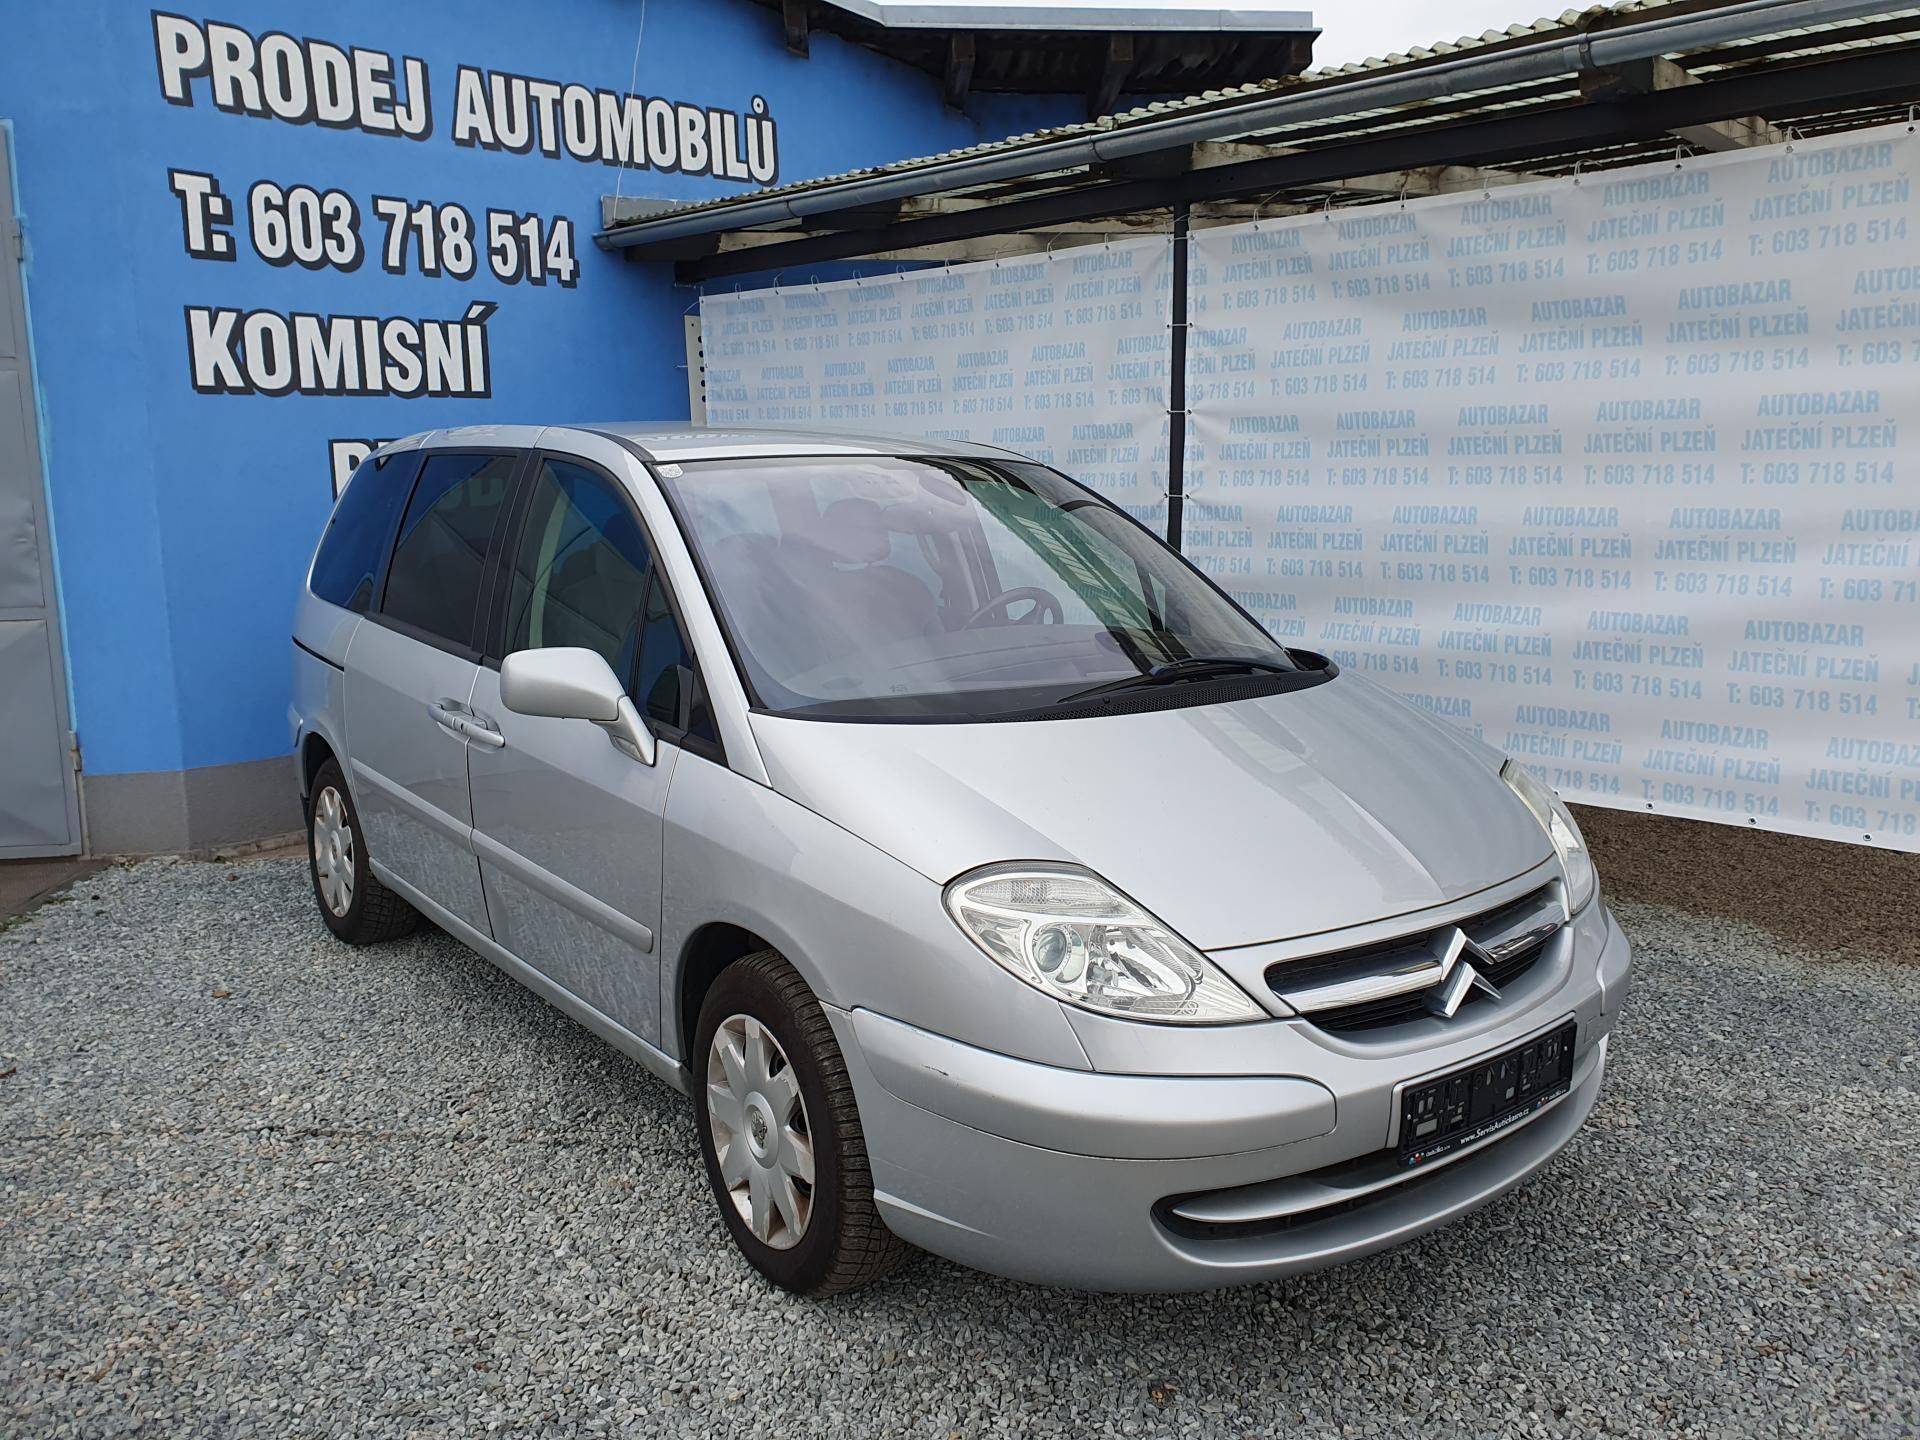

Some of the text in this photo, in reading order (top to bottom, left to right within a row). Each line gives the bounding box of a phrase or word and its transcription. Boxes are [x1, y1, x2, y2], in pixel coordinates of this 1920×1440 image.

[154, 12, 777, 184] PRODEJ AUTOMOBILŮ
[1768, 144, 1893, 184] AUTOBAZAR
[1603, 171, 1710, 207] AUTOBAZAR
[1749, 172, 1909, 221] JATEČNÍ PLZEŇ
[1460, 195, 1553, 226] AUTOBAZAR
[1586, 198, 1723, 244] JATEČNÍ PLZEŇ
[171, 170, 577, 284] T: 603 718 514
[1446, 219, 1565, 258] JATEČNÍ PLZEŇ
[1748, 217, 1906, 256] T: 603 718 514
[1071, 252, 1134, 276] AUTOBAZAR
[1586, 239, 1722, 273] T: 603 718 514
[989, 264, 1046, 286] AUTOBAZAR
[1447, 257, 1563, 288] T: 603 718 514
[1531, 295, 1627, 321] AUTOBAZAR
[1678, 279, 1791, 310] AUTOBAZAR
[995, 317, 1014, 333] 603
[1017, 315, 1034, 330] 718
[1036, 312, 1052, 328] 514
[1075, 307, 1093, 324] 603
[1097, 304, 1116, 321] 718
[1119, 302, 1142, 320] 514
[1402, 307, 1487, 331] AUTOBAZAR
[1665, 306, 1808, 343] JATEČNÍ PLZEŇ
[187, 302, 491, 394] KOMISNÍ
[1387, 331, 1498, 360] JATEČNÍ PLZEŇ
[1518, 320, 1642, 353] JATEČNÍ PLZEŇ
[956, 349, 1009, 369] AUTOBAZAR
[1031, 342, 1085, 361] AUTOBAZAR
[1665, 348, 1808, 375] T: 603 718 514
[1385, 366, 1495, 389] T: 603 718 514
[1516, 359, 1640, 383] T: 603 718 514
[961, 399, 977, 413] 603
[980, 397, 994, 412] 718
[996, 396, 1013, 411] 514
[1034, 394, 1051, 409] 603
[1054, 392, 1072, 408] 718
[1075, 392, 1094, 407] 514
[1596, 399, 1700, 422] AUTOBAZAR
[1756, 391, 1879, 416] AUTOBAZAR
[1335, 410, 1415, 431] AUTOBAZAR
[1457, 404, 1548, 426] AUTOBAZAR
[1327, 433, 1429, 458] JATEČNÍ PLZEŇ
[1447, 429, 1562, 456] JATEČNÍ PLZEŇ
[1583, 424, 1716, 453] JATEČNÍ PLZEŇ
[1740, 419, 1896, 451] JATEČNÍ PLZEŇ
[1326, 467, 1428, 486] T: 603 718 514
[1447, 465, 1562, 485] T: 603 718 514
[1583, 464, 1714, 484] T: 603 718 514
[1740, 462, 1894, 484] T: 603 718 514
[1392, 506, 1477, 525] AUTOBAZAR
[1668, 508, 1780, 530] AUTOBAZAR
[1379, 528, 1488, 555] JATEČNÍ PLZEŇ
[1653, 533, 1796, 563] JATEČNÍ PLZEŇ
[1379, 562, 1489, 583] T: 603 718 514
[1653, 571, 1792, 597] T: 603 718 514
[1454, 603, 1542, 625] AUTOBAZAR
[1587, 611, 1688, 636] AUTOBAZAR
[1437, 629, 1551, 657] JATEČNÍ PLZEŇ
[1743, 620, 1864, 646] AUTOBAZAR
[1572, 638, 1703, 668] JATEČNÍ PLZEŇ
[1727, 648, 1878, 682] JATEČNÍ PLZEŇ
[1436, 659, 1552, 686] T: 603 718 514
[1572, 670, 1701, 699] T: 603 718 514
[1726, 683, 1877, 716] T: 603 718 514
[1660, 720, 1768, 750] AUTOBAZAR
[1642, 748, 1780, 784] JATEČNÍ PLZEŇ
[1640, 779, 1778, 816] T: 603 718 514
